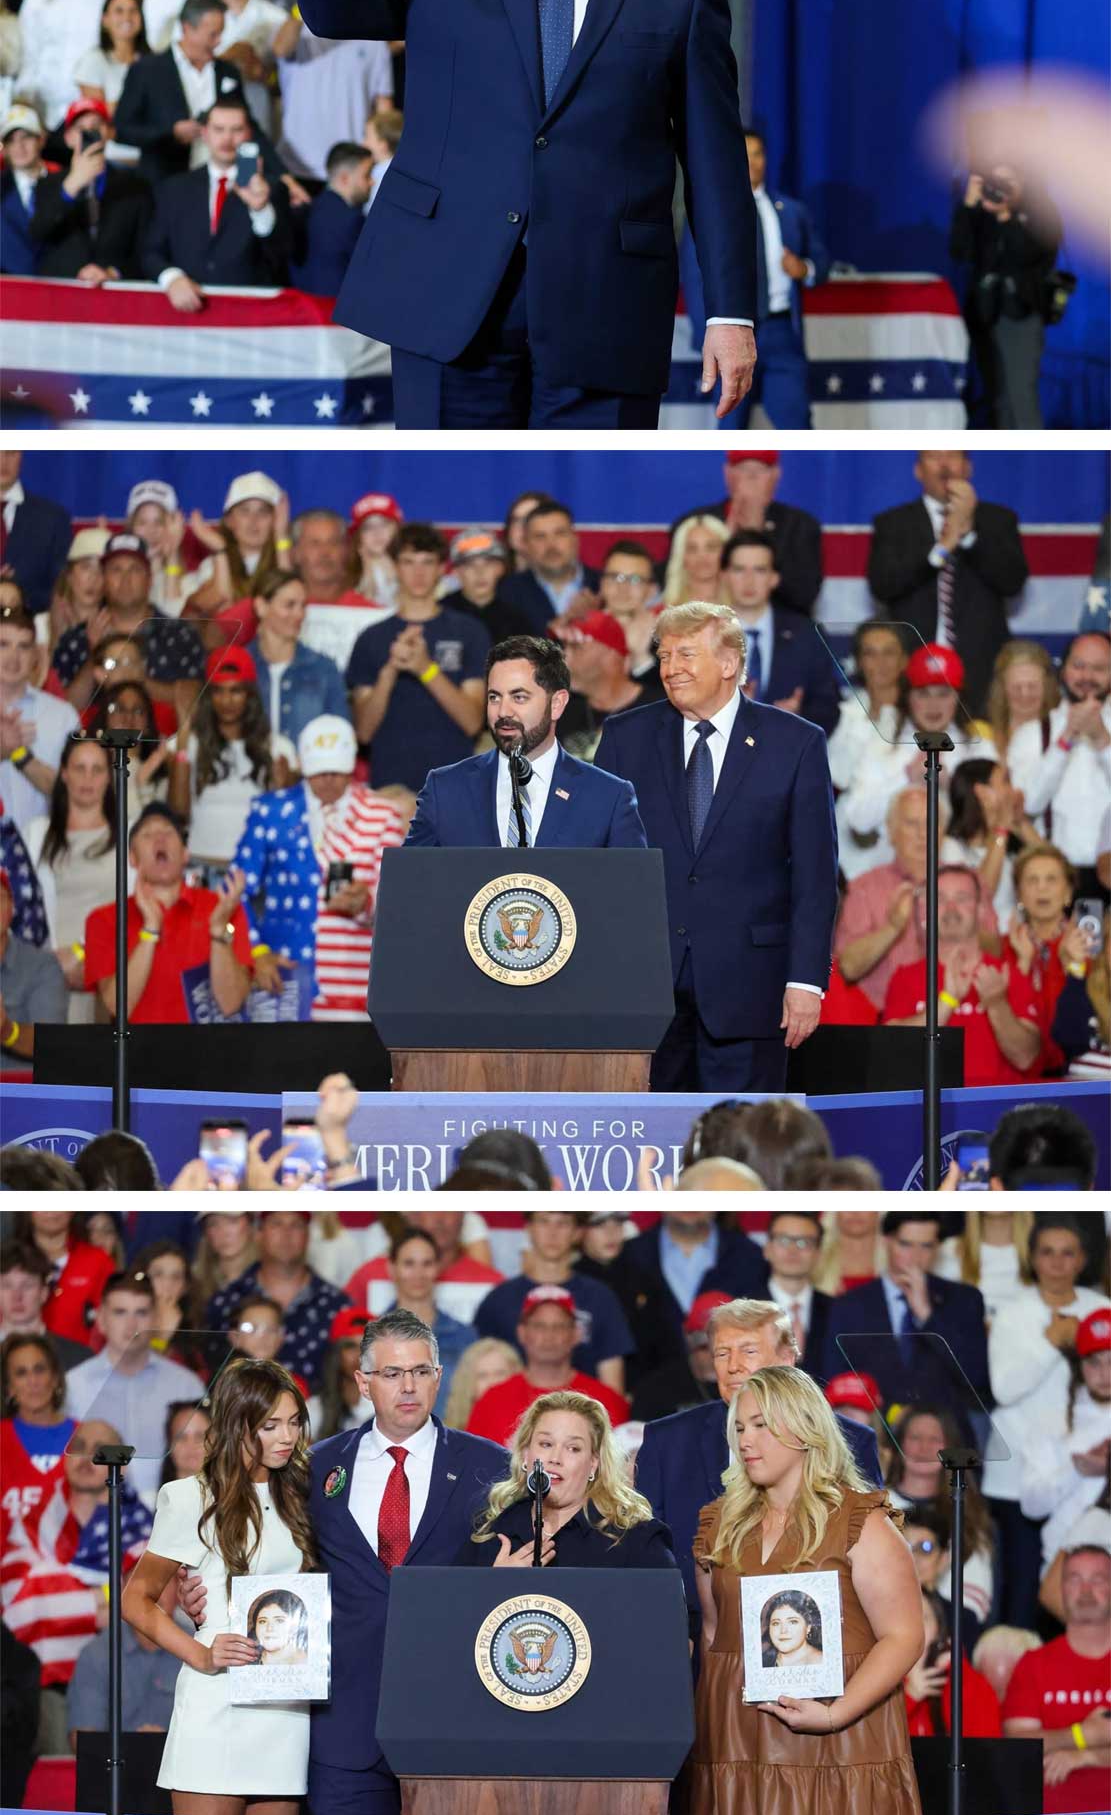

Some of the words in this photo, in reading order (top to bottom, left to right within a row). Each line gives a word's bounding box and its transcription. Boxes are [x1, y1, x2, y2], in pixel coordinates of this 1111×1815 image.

[521, 878, 532, 886] OF
[468, 877, 519, 926] PRESIDENT
[550, 891, 573, 936] UNITED
[482, 962, 510, 979] SEAL
[530, 946, 568, 979] STATES
[444, 1120, 579, 1138] FIGHTING
[593, 1120, 646, 1138] FOR
[480, 1598, 531, 1650] PRESIDENT
[564, 1613, 588, 1660] UNITED
[494, 1682, 523, 1705] SEAL
[543, 1670, 582, 1705] STATES
